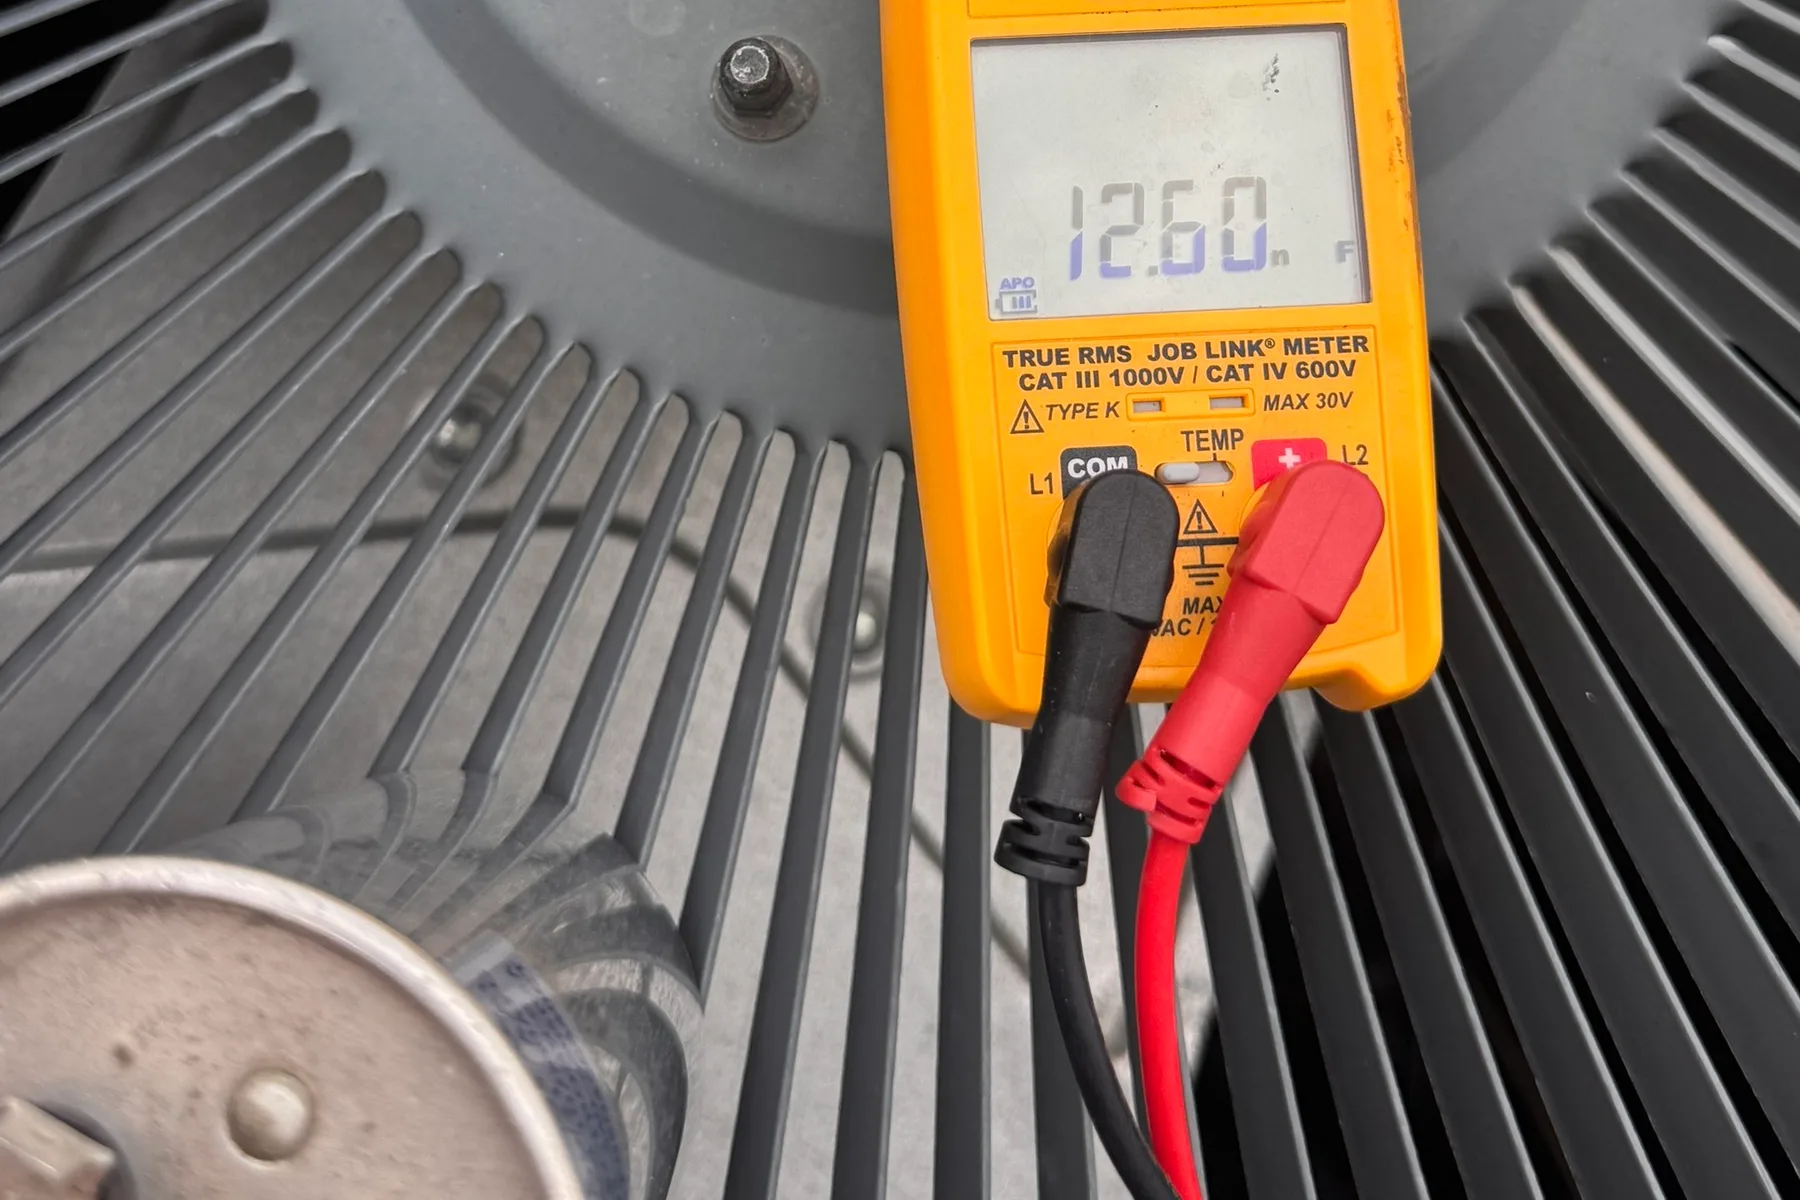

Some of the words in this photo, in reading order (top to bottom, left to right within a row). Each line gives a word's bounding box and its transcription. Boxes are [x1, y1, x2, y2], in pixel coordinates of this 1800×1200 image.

[1070, 176, 1267, 281] 12.60
[1000, 277, 1035, 290] APO
[1003, 348, 1070, 368] TRUE
[1078, 345, 1132, 364] RMS
[1147, 342, 1197, 362] JOB
[1283, 335, 1370, 356] METER
[1019, 372, 1067, 391] CAT
[1076, 370, 1100, 389] III
[1109, 367, 1184, 387] 1000V
[1192, 365, 1198, 385] /
[1206, 363, 1254, 383] CAT
[1263, 362, 1287, 381] IV
[1296, 360, 1357, 379] 600V
[1045, 402, 1101, 421] TYPE
[1105, 401, 1121, 418] K
[1263, 393, 1312, 412] MAX
[1316, 391, 1354, 409] 30V
[1180, 428, 1244, 452] TEMP
[1342, 445, 1369, 466] L2
[1030, 472, 1054, 495] L1
